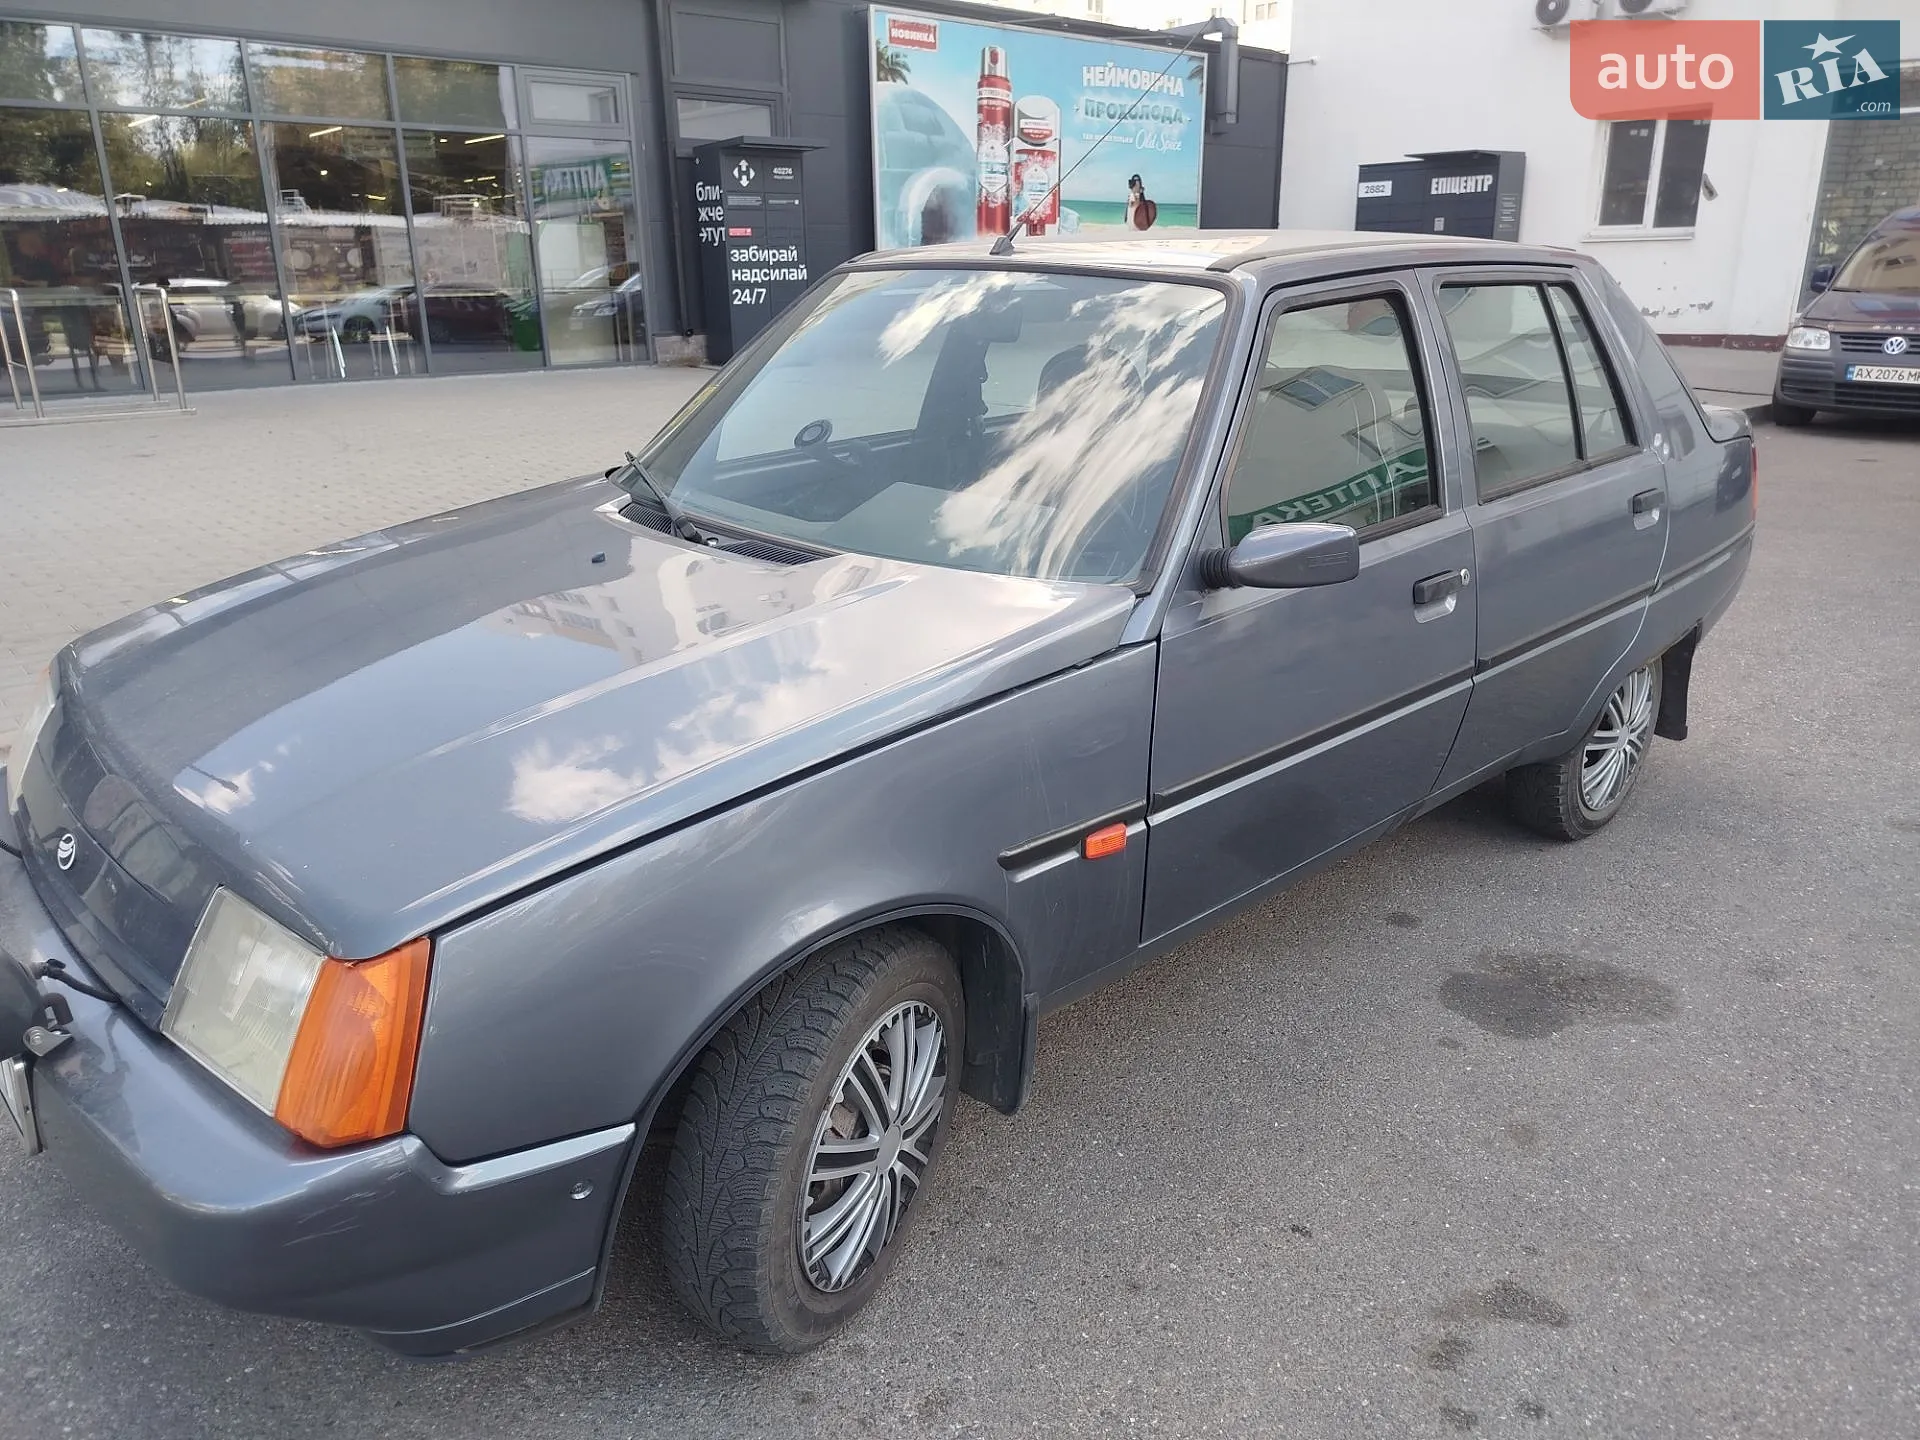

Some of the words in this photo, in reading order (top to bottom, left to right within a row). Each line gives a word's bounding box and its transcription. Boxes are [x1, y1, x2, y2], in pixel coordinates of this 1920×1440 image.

[891, 28, 935, 43] НОВИНКА
[1082, 61, 1185, 98] НЕЙМОВІРНА
[1084, 98, 1184, 124] ПРОХОЛОДА
[1135, 128, 1157, 150] Old
[1156, 132, 1183, 153] Spice
[695, 182, 724, 202] бли-
[1431, 174, 1493, 195] ЕПІЦЕНТР
[697, 205, 724, 222] жче
[730, 245, 798, 266] забирай
[731, 264, 808, 284] надсилай
[732, 287, 767, 305] 24/7
[1855, 368, 1873, 378] AX
[1876, 369, 1905, 380] 2076
